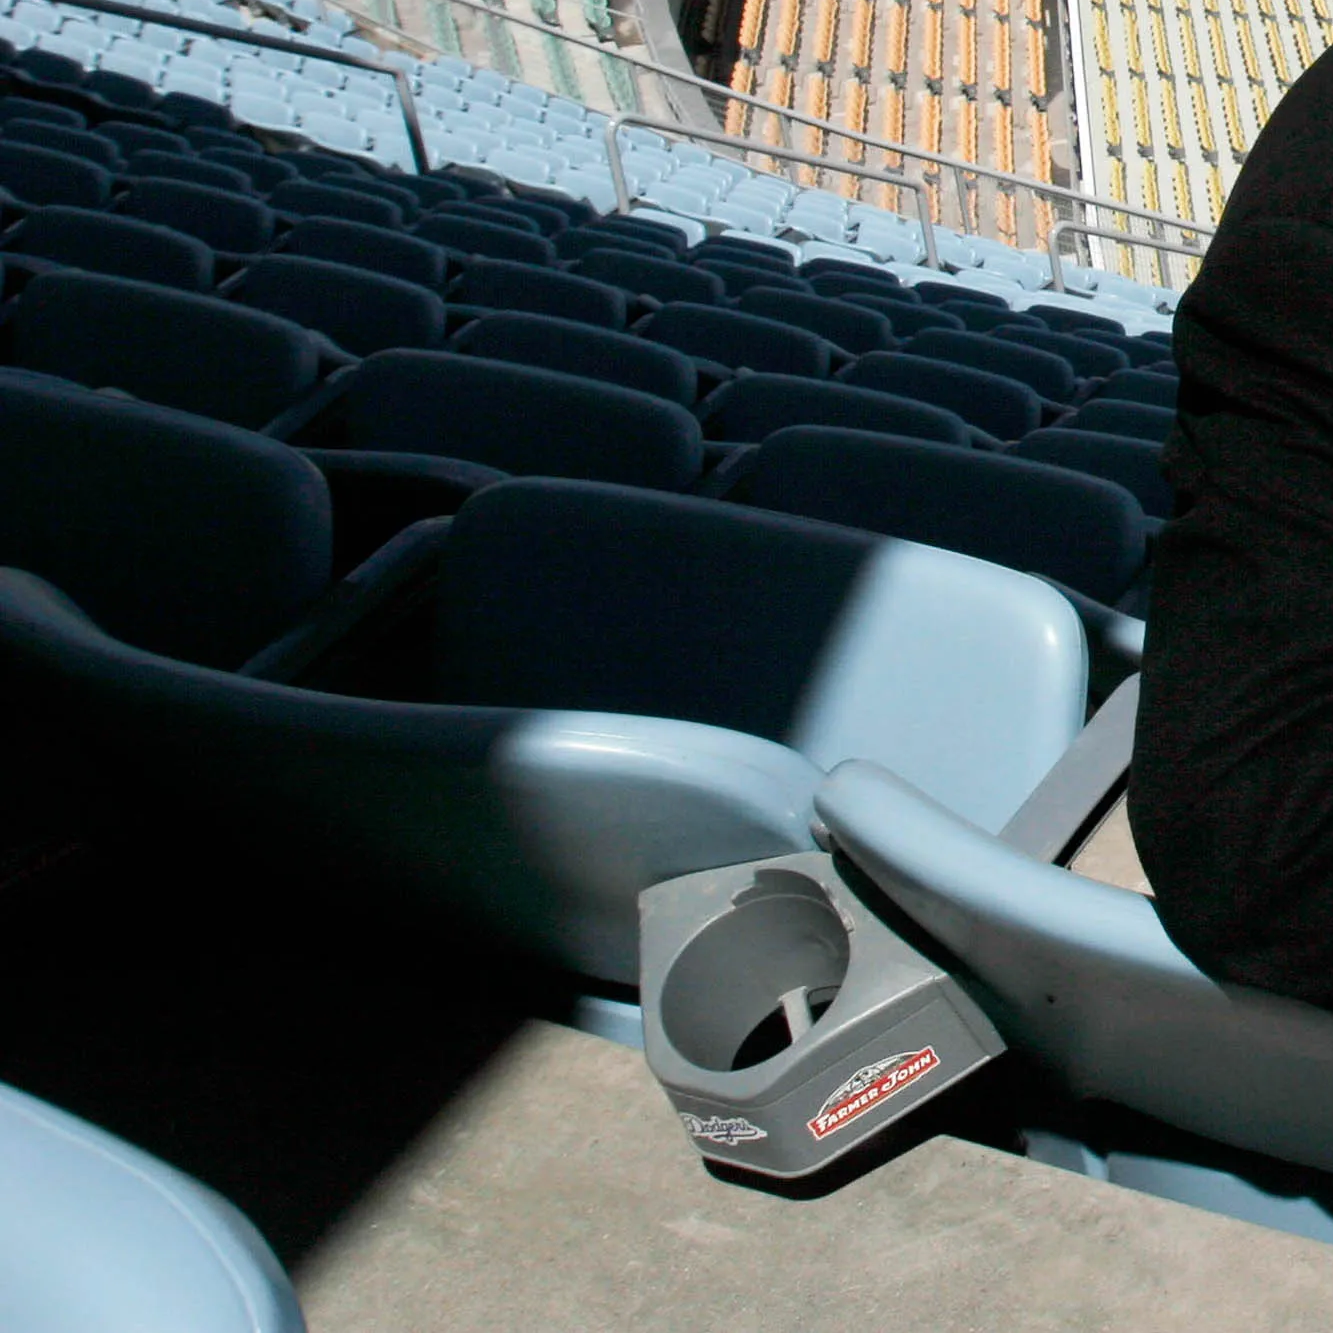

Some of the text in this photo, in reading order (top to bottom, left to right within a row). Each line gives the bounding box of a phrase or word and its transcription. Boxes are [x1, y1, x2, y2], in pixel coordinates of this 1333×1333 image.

[816, 1053, 932, 1133] FARMER JOHN
[685, 1115, 766, 1144] Dodgers
